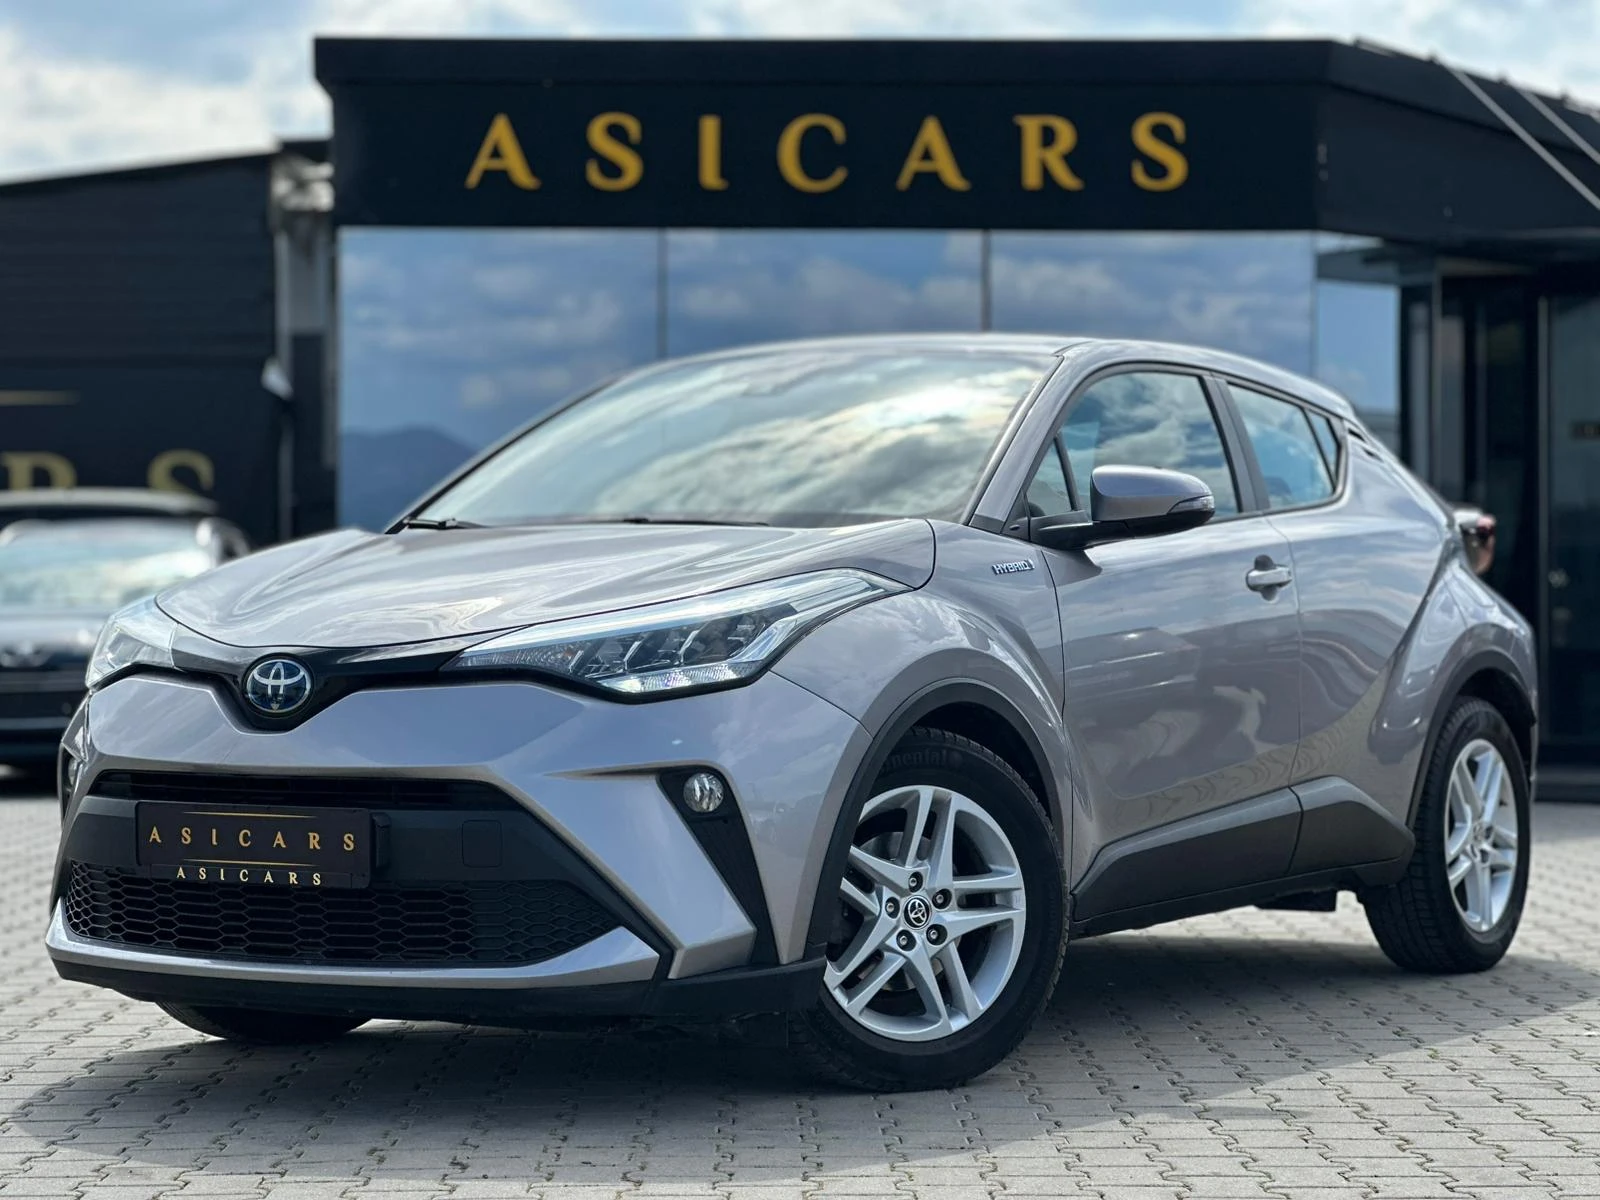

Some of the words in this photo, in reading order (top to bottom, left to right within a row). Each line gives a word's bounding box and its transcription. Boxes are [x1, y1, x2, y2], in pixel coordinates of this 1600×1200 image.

[464, 111, 1190, 192] ASICARS
[992, 560, 1031, 575] HYBRID
[149, 826, 355, 851] ASICARS
[176, 866, 322, 886] ASICARS
